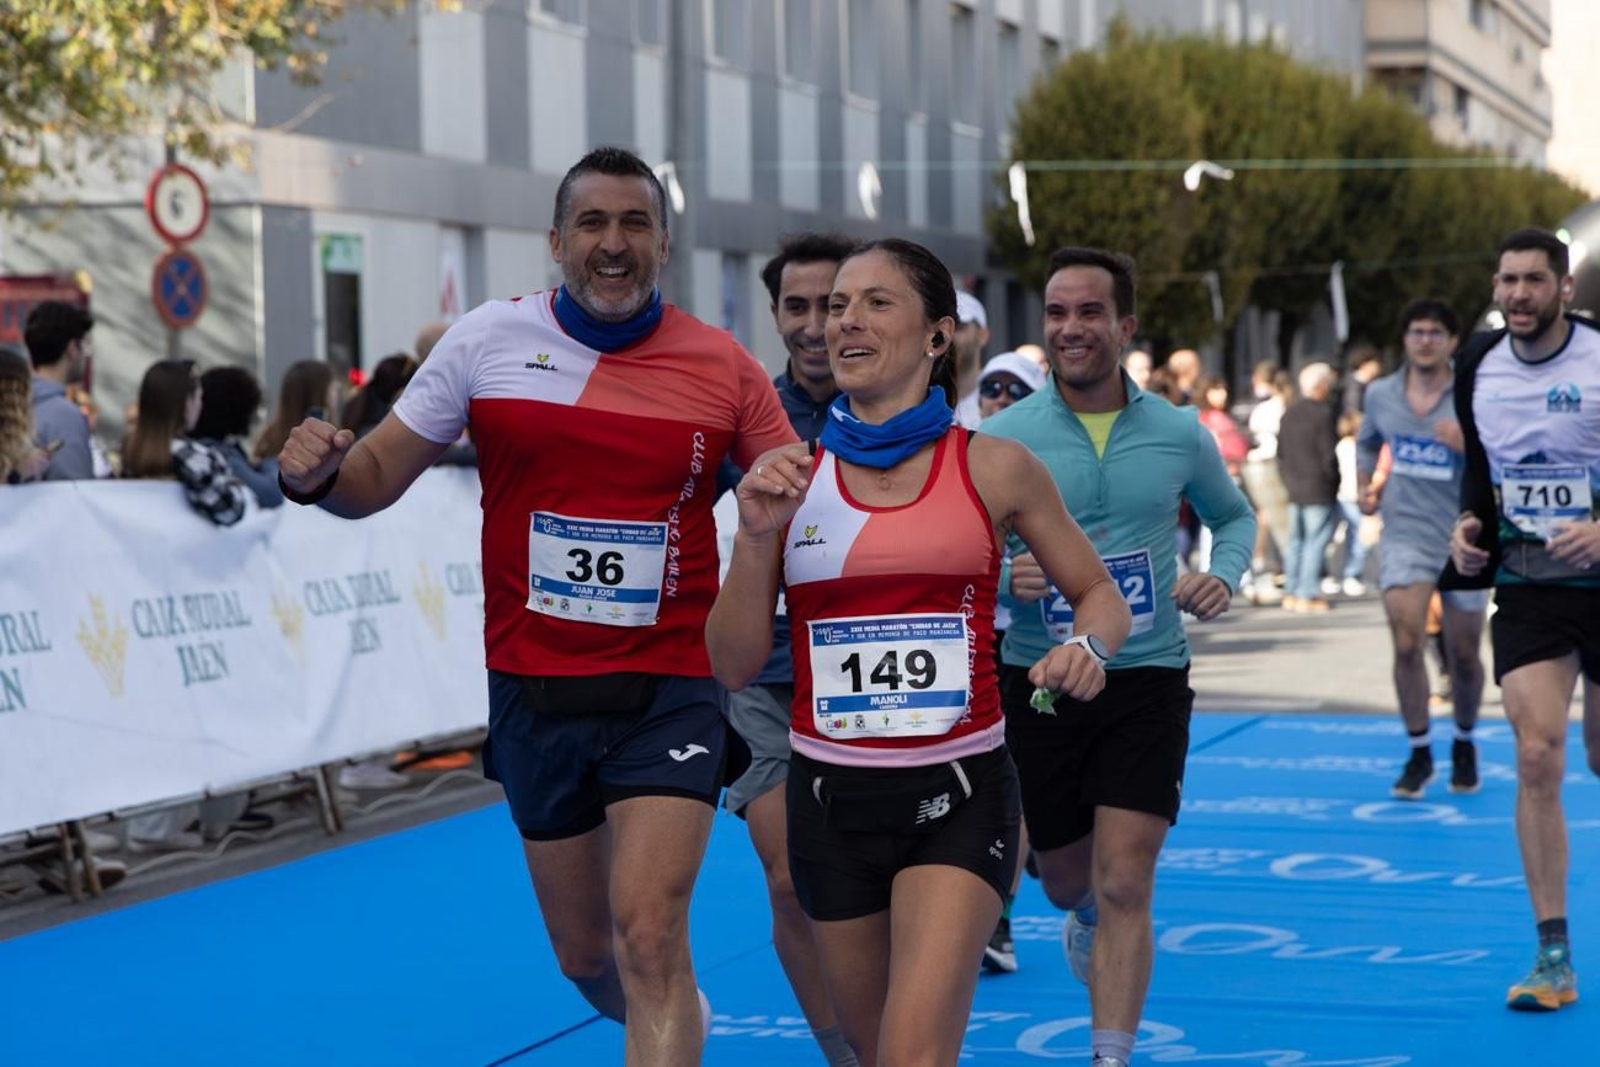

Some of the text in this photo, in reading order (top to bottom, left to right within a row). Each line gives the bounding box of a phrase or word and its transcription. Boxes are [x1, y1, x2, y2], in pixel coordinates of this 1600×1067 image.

[691, 432, 705, 474] CLUB
[1517, 485, 1571, 507] 710
[565, 548, 624, 586] 36
[571, 585, 593, 595] JUAN
[841, 649, 938, 693] 149
[870, 694, 908, 706] MANOLI
